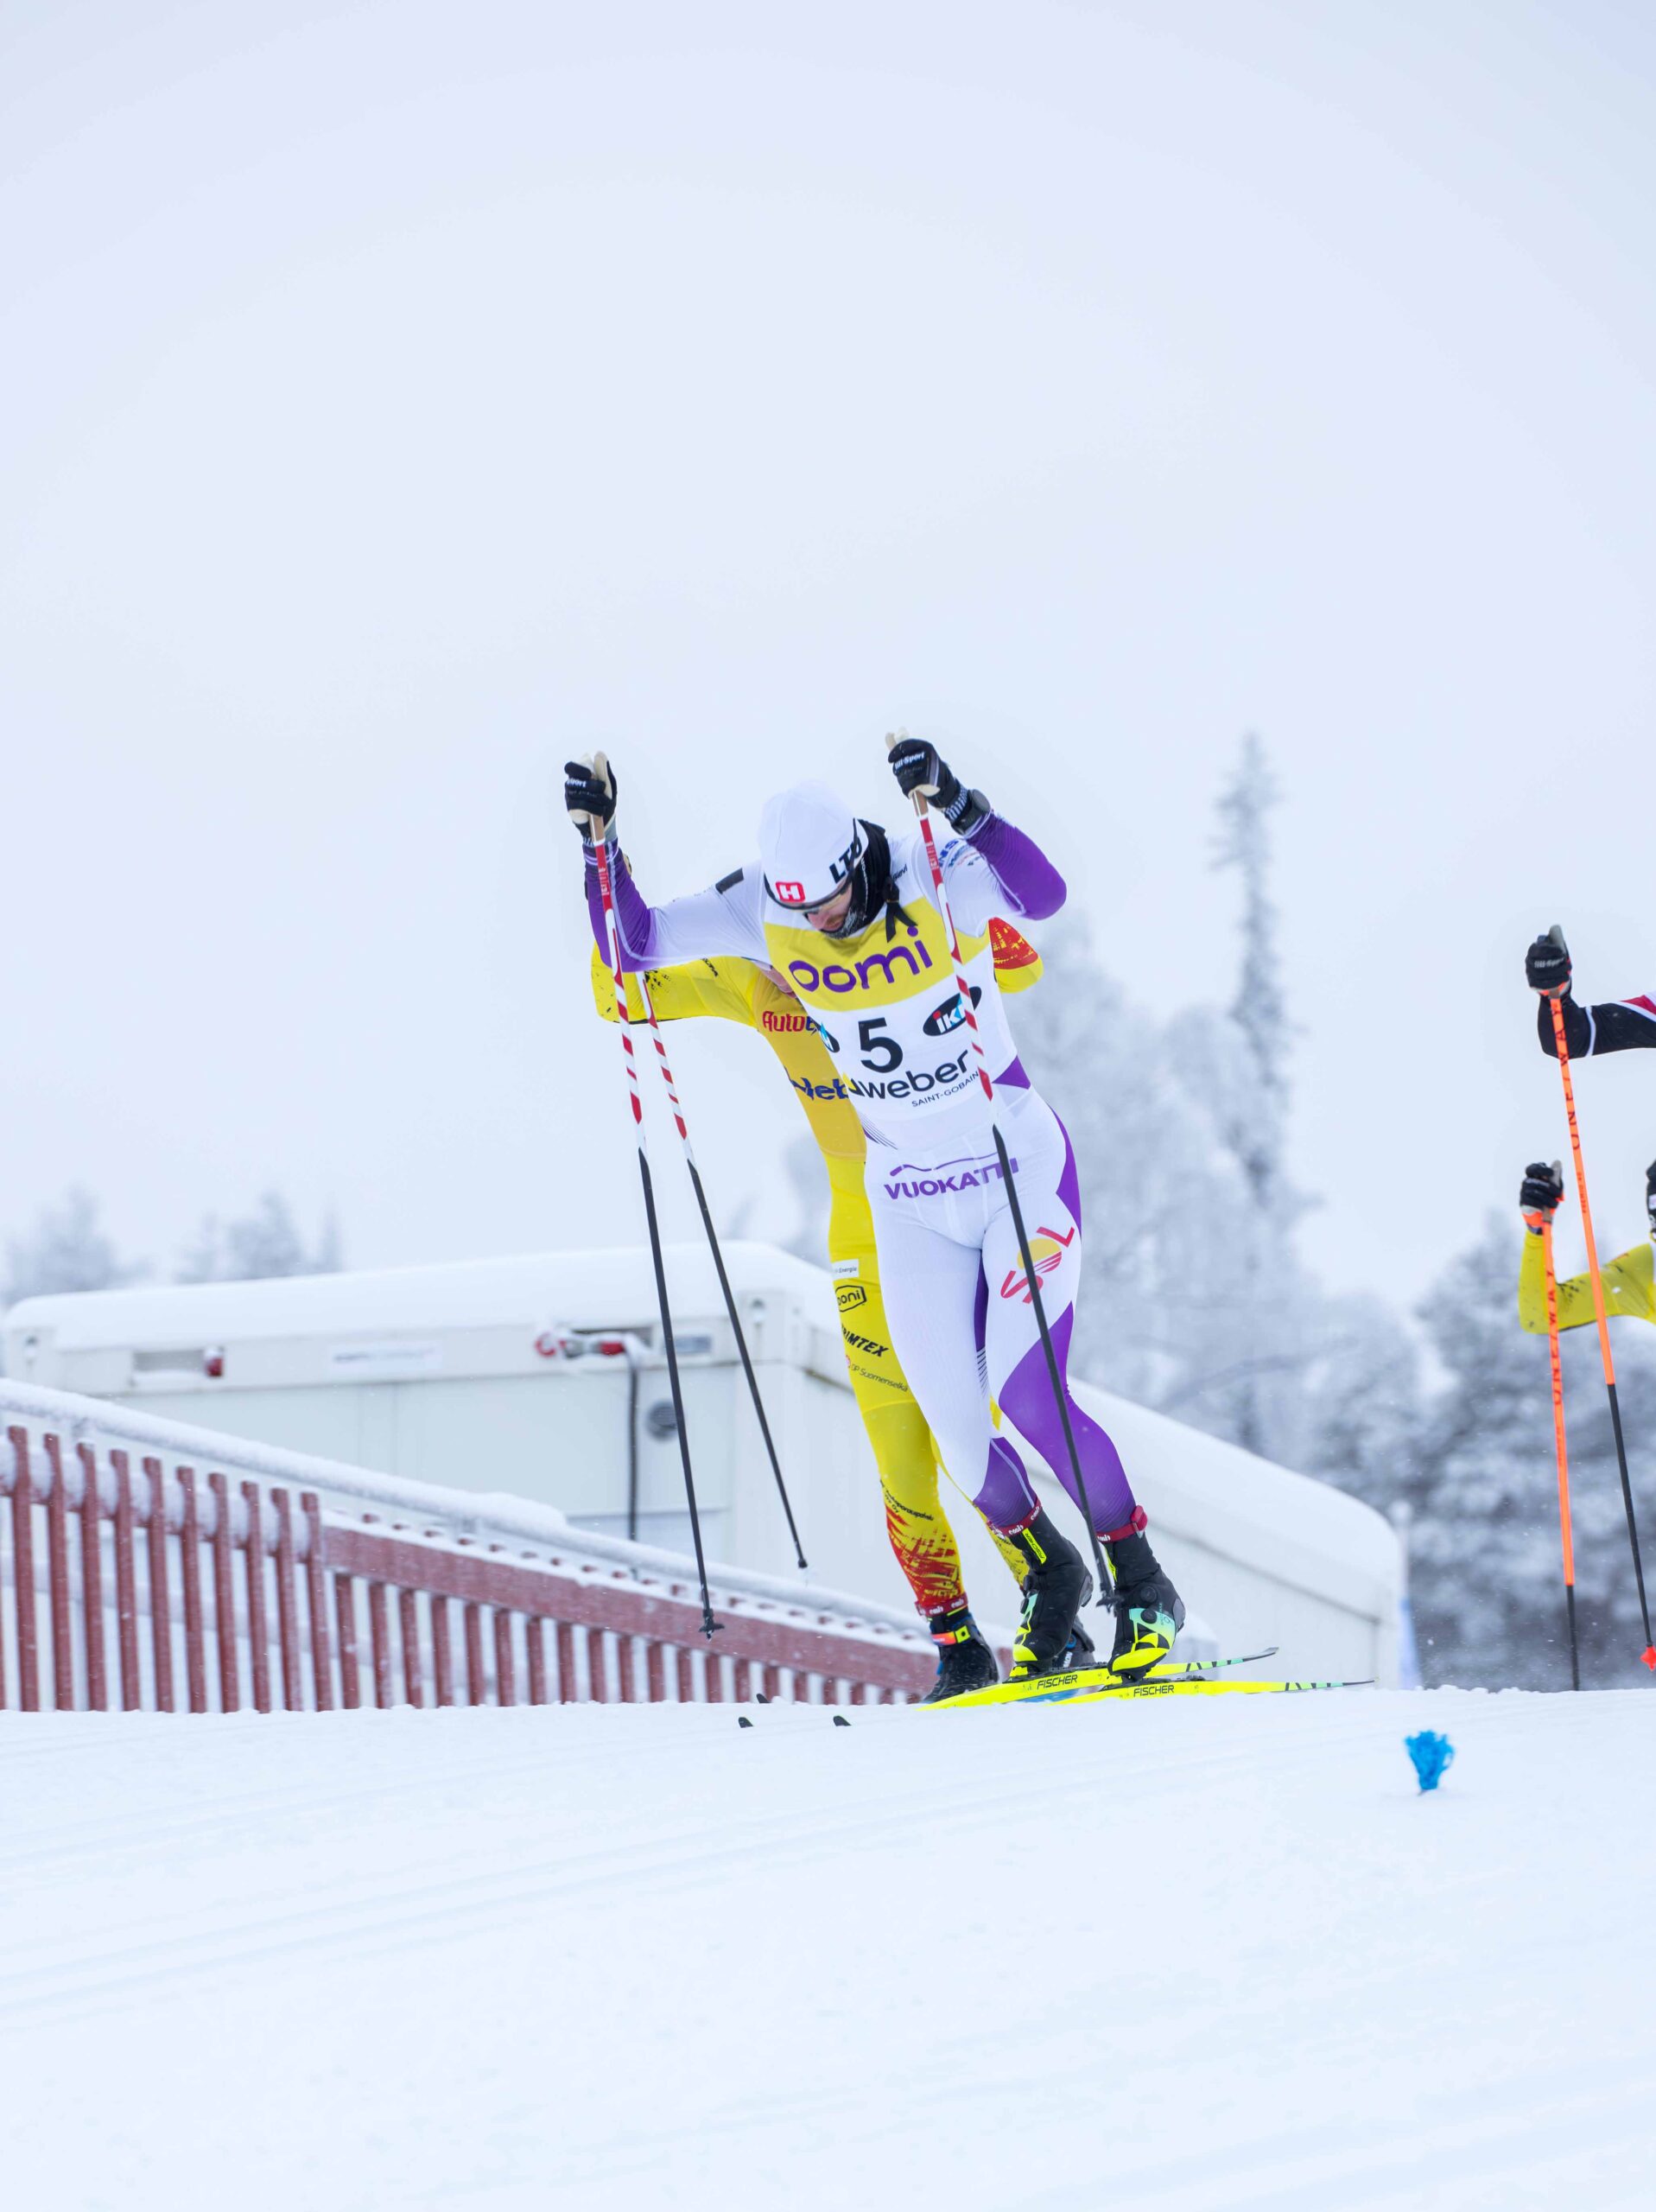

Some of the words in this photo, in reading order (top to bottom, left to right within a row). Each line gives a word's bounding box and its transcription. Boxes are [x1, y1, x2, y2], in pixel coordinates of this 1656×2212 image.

[780, 883, 801, 900] H
[788, 925, 933, 993] oomi
[858, 1017, 904, 1073] 5
[856, 1050, 968, 1101] weber
[911, 1071, 980, 1108] SAINT-GOBAIN
[884, 1157, 1019, 1200] VUOKATTI
[1037, 1674, 1078, 1690] FISCHER
[1133, 1684, 1175, 1698] FISCHER
